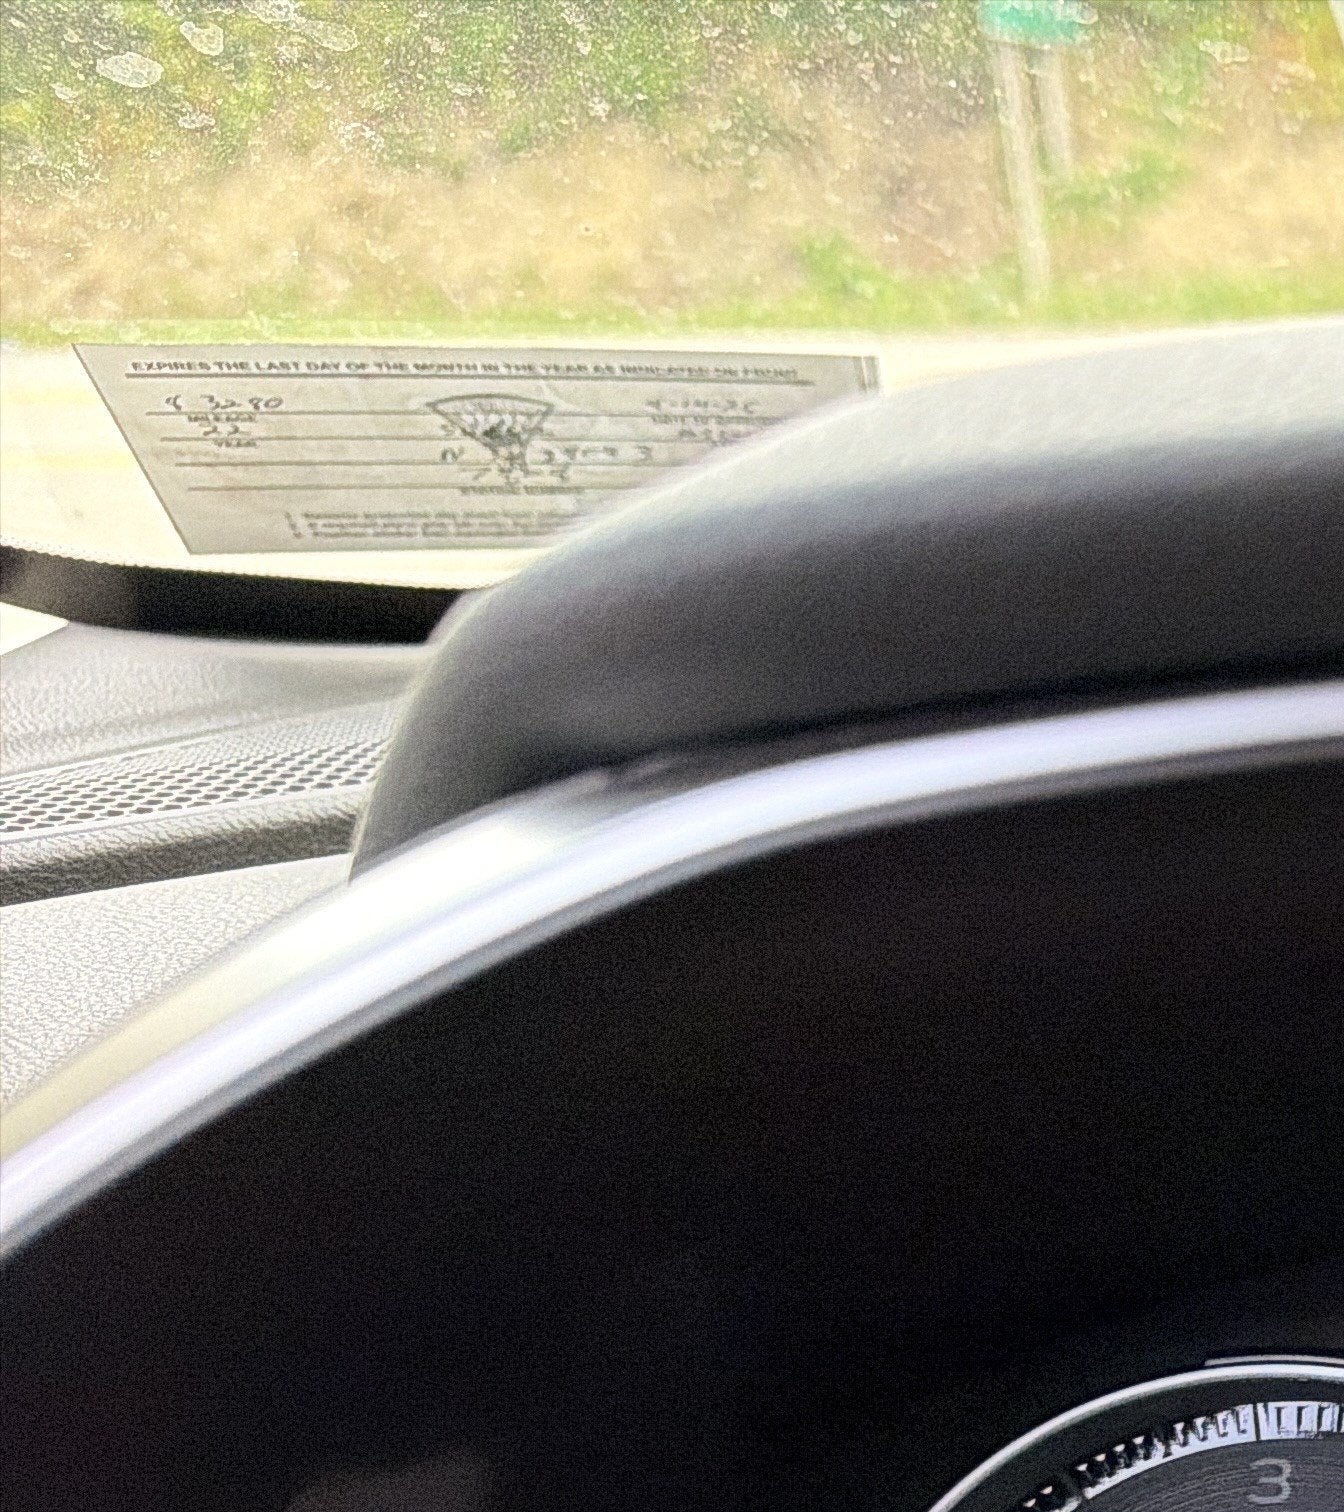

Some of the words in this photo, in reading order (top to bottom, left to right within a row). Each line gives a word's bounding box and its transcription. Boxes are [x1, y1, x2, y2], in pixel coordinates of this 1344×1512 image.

[214, 361, 250, 371] THE
[255, 361, 301, 371] LAST
[1248, 1458, 1292, 1504] 3
